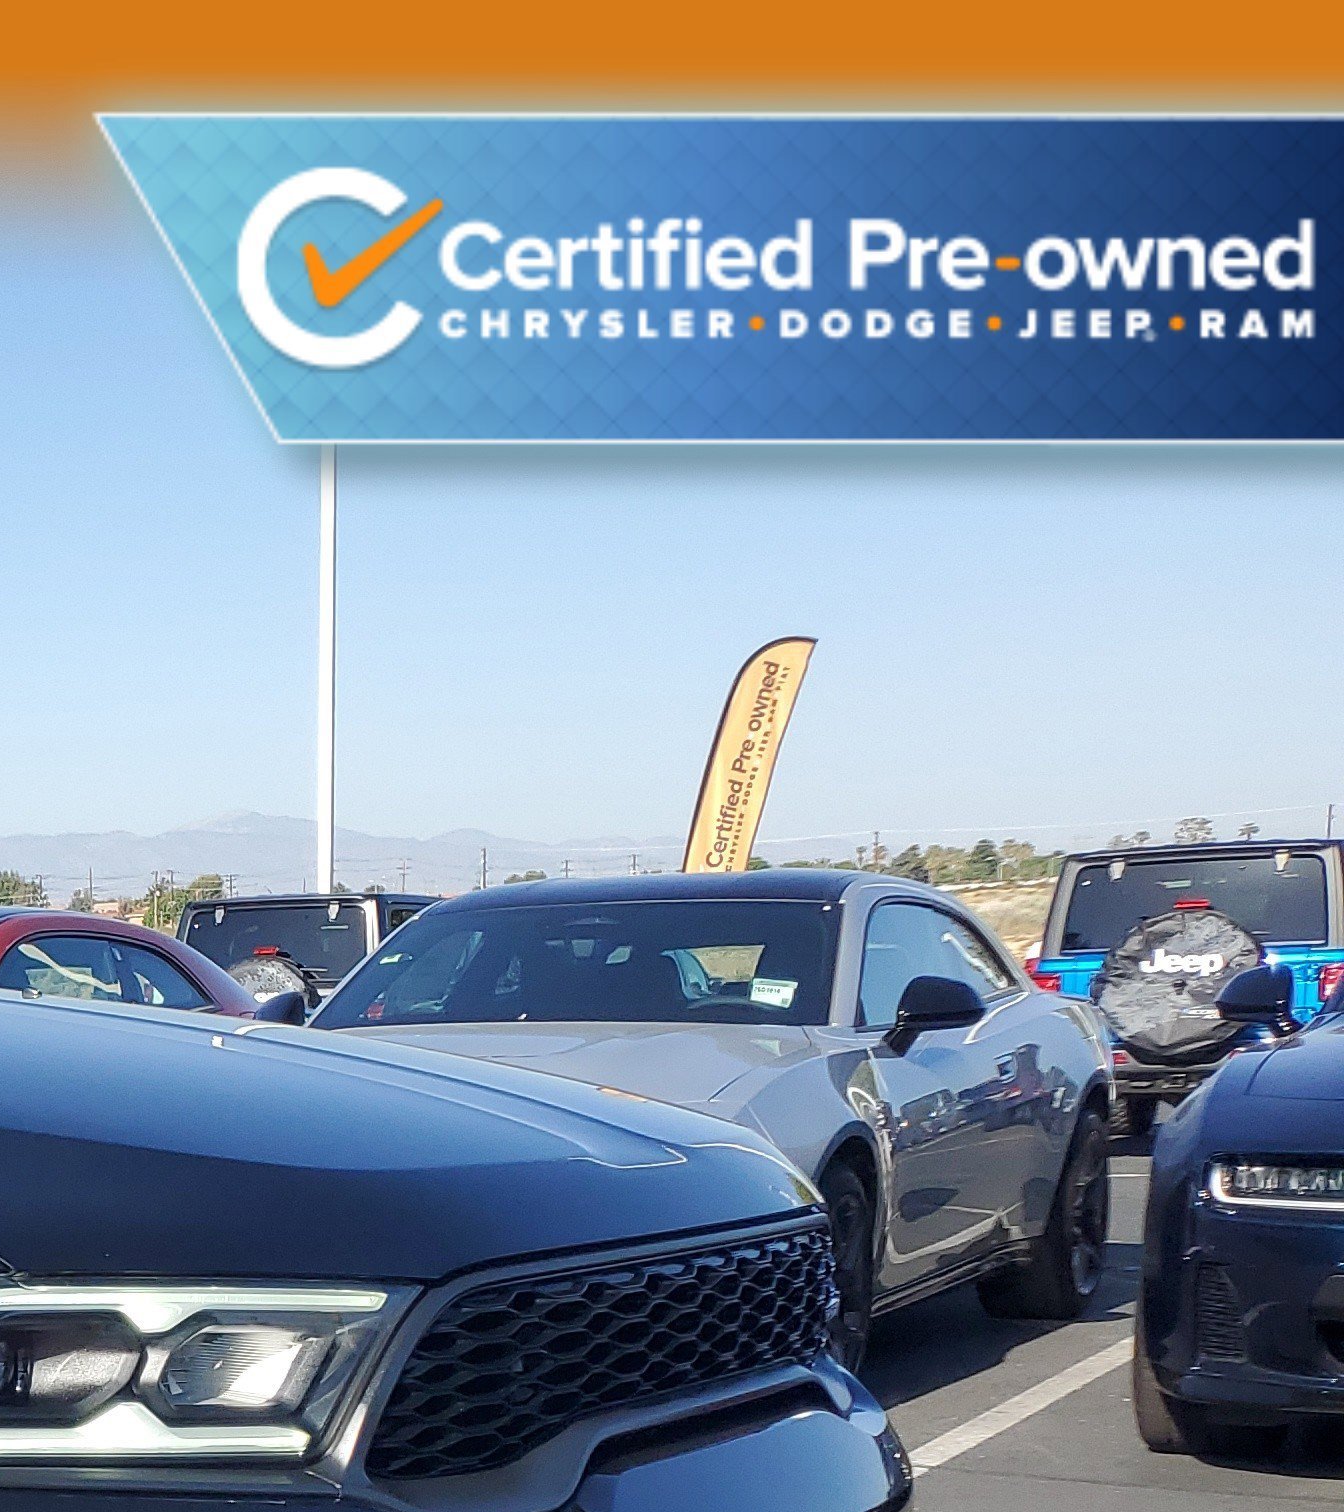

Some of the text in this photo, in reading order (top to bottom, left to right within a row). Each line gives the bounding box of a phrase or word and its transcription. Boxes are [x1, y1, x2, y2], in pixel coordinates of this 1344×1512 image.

[741, 767, 758, 806] DODGE
[705, 779, 743, 868] Certified
[1139, 948, 1225, 977] Jeep
